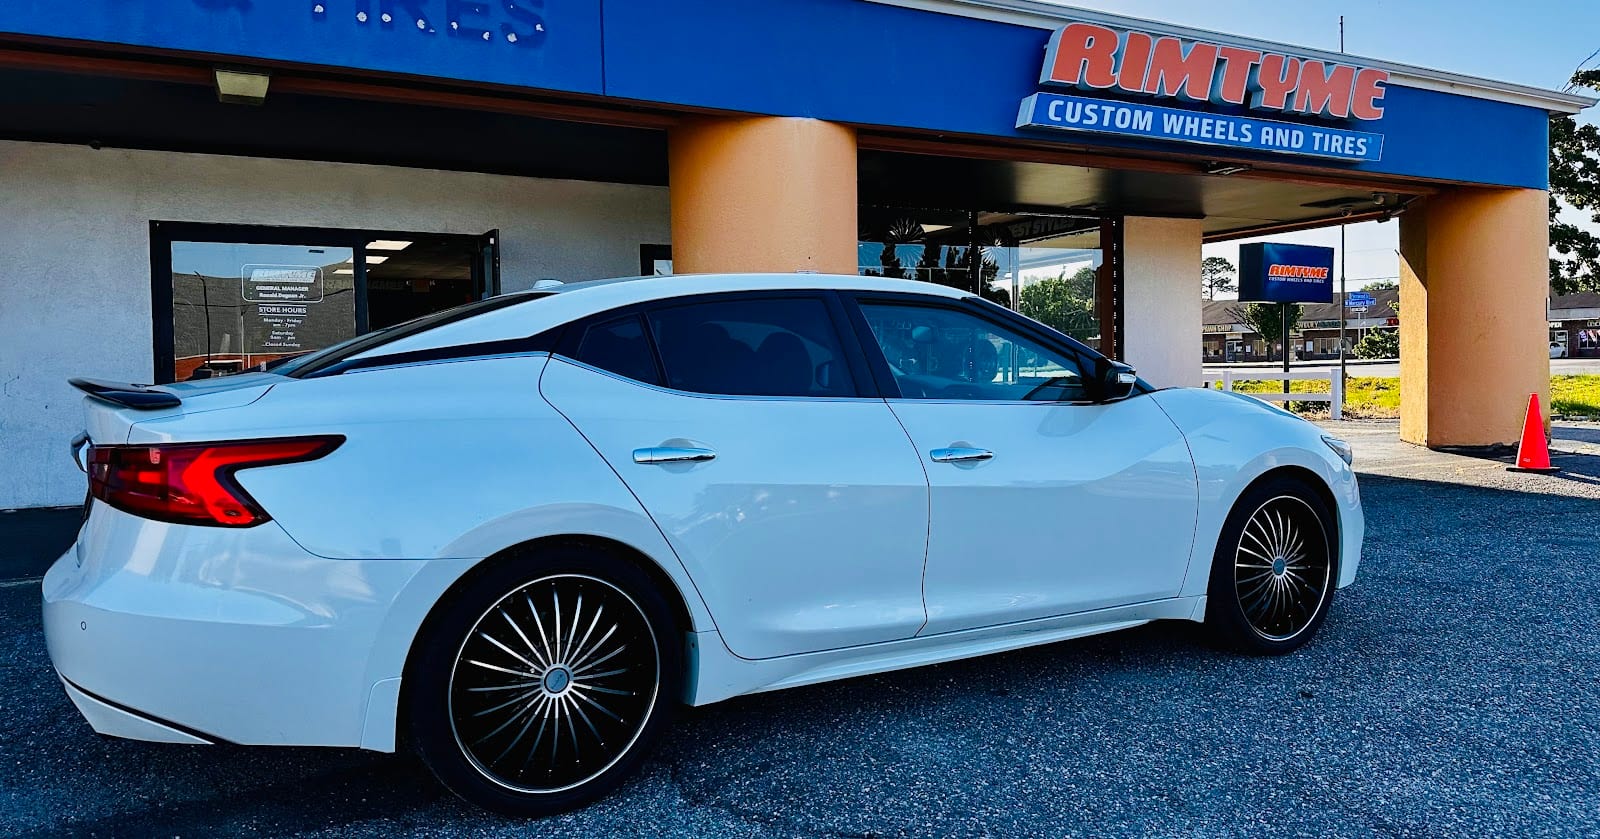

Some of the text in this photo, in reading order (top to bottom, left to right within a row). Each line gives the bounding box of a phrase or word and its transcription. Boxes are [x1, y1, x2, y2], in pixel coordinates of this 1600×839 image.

[1049, 23, 1390, 120] RIMTYME
[1048, 100, 1367, 156] CUSTOM WHEELS AND TIRES
[1268, 264, 1328, 279] RIMTYME
